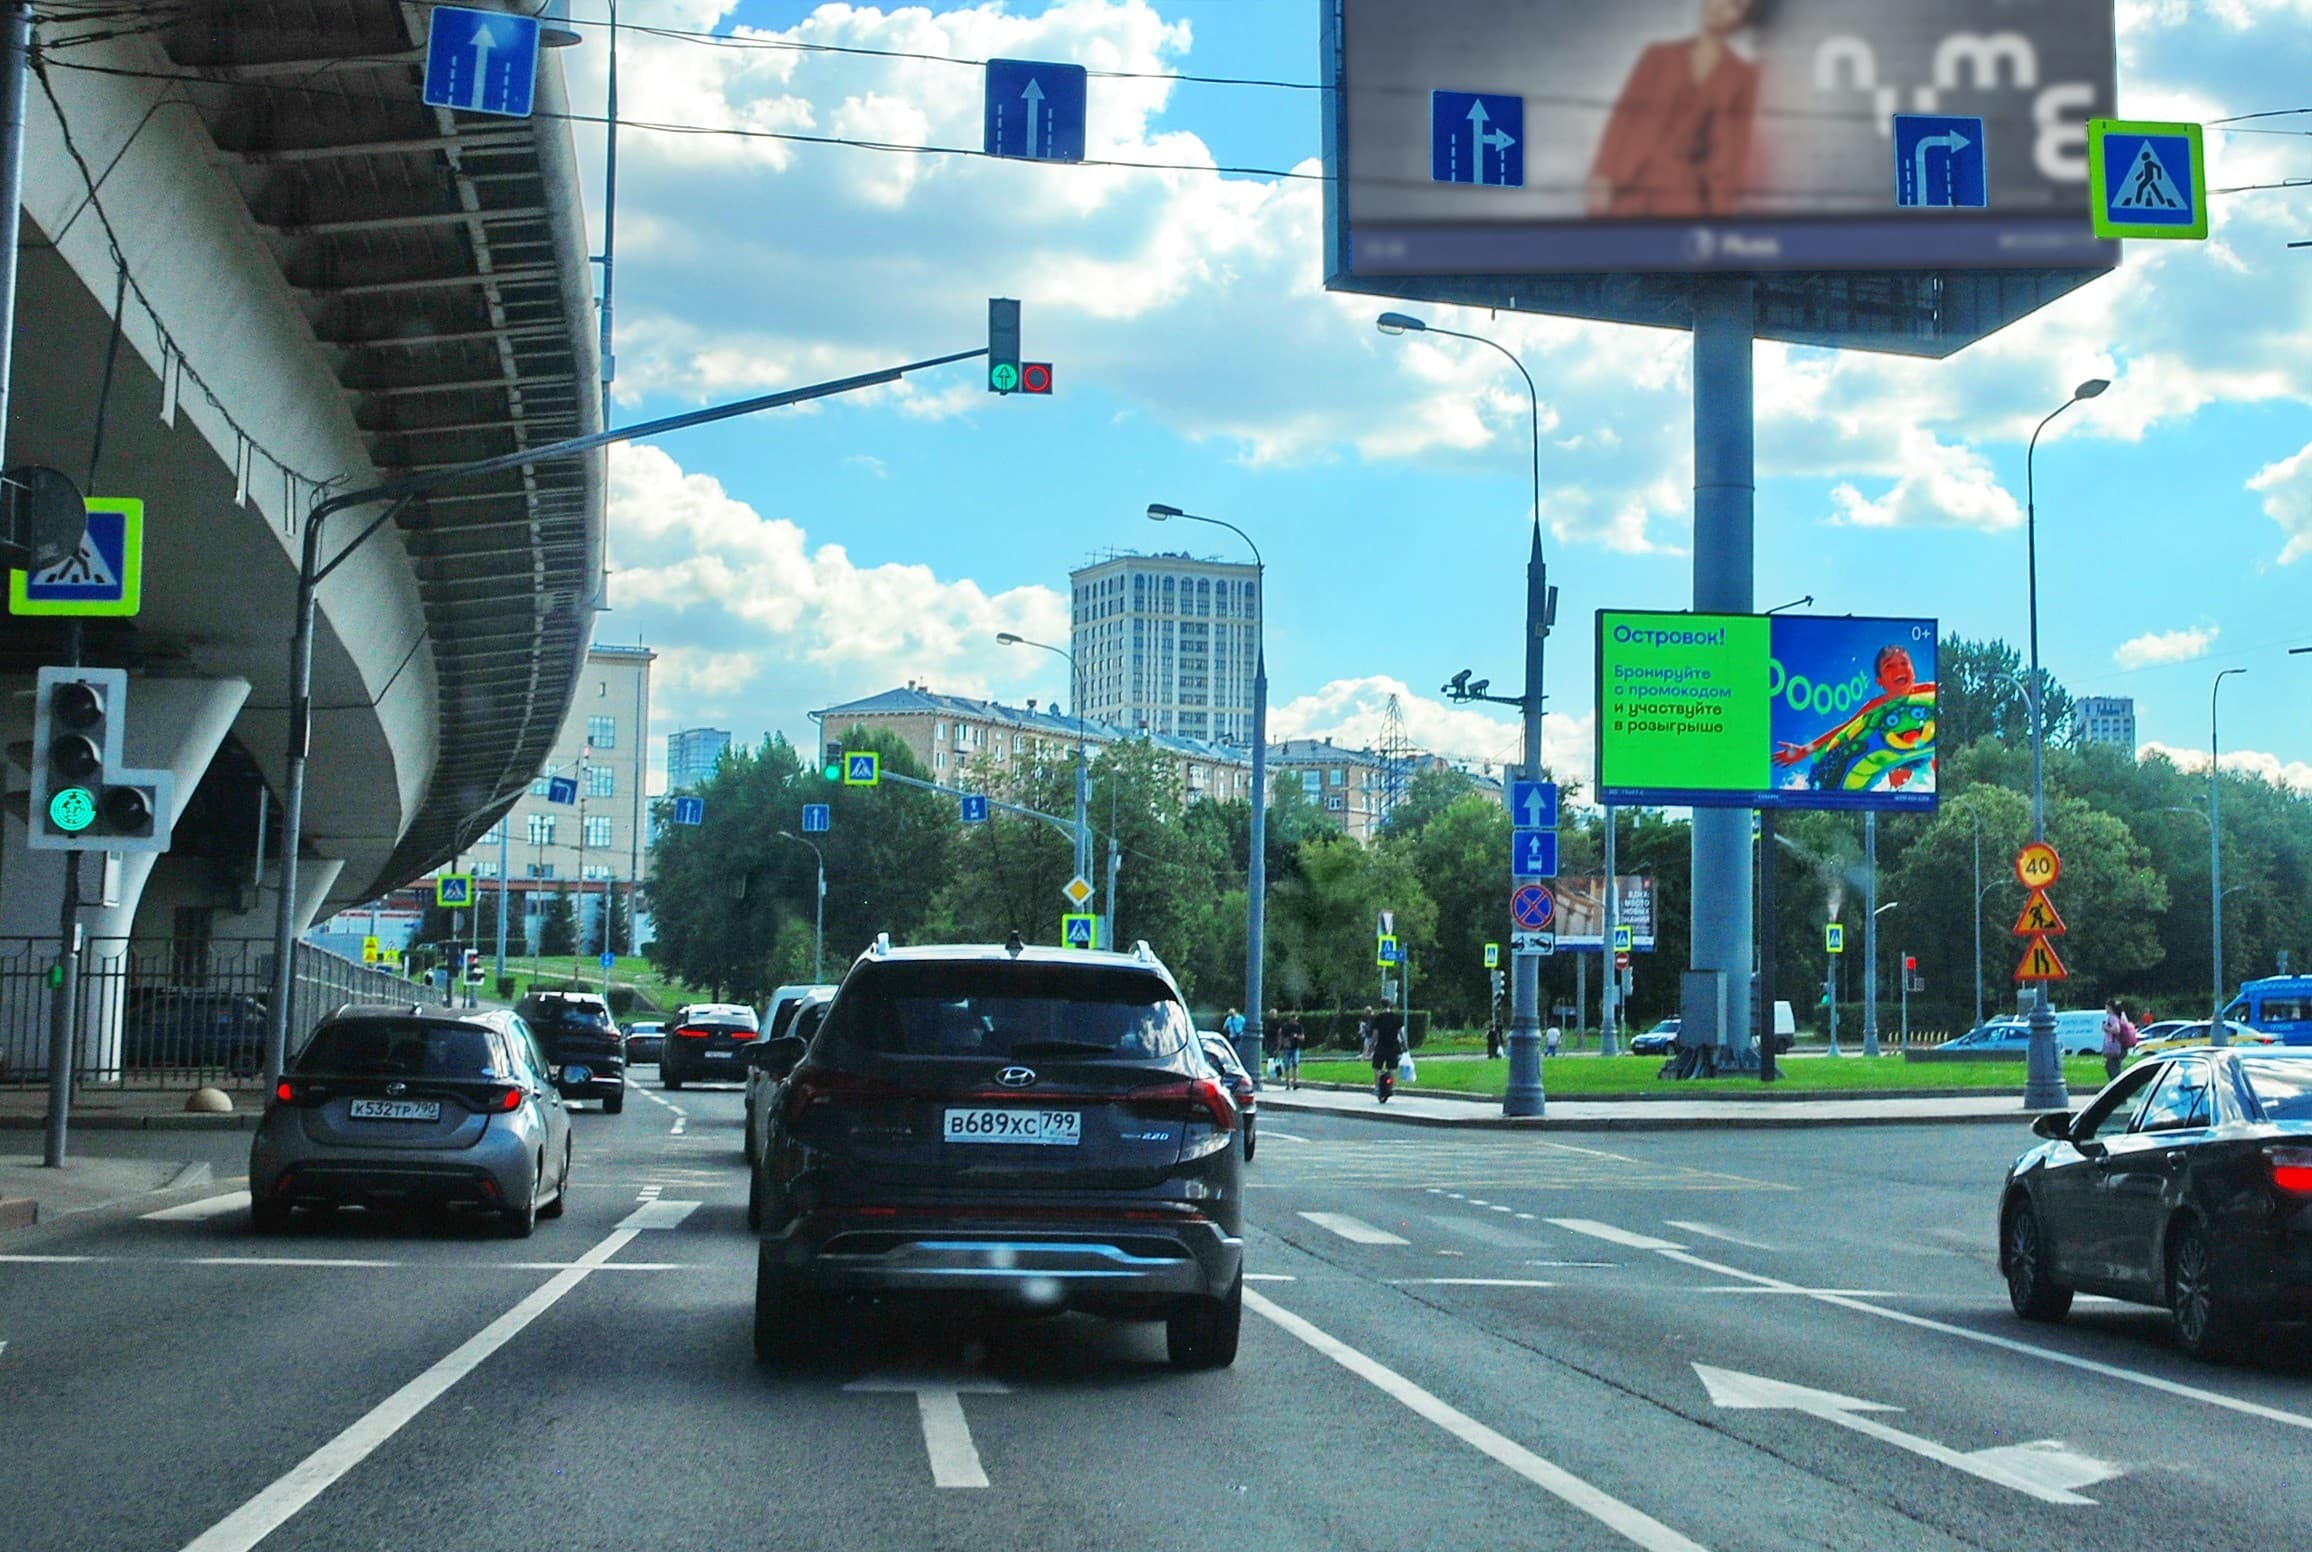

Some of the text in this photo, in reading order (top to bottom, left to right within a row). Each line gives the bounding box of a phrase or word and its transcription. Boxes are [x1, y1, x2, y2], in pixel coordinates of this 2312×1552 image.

[1613, 624, 1725, 647] Островок!
[1911, 626, 1931, 641] 0+
[1614, 664, 1711, 683] Бронируйте
[1614, 685, 1732, 699] с промокодом
[1614, 702, 1722, 719] и участвуйте
[1614, 721, 1723, 735] в розыгрыше
[2025, 857, 2050, 875] 40
[951, 1111, 1075, 1135] В689ХС 799
